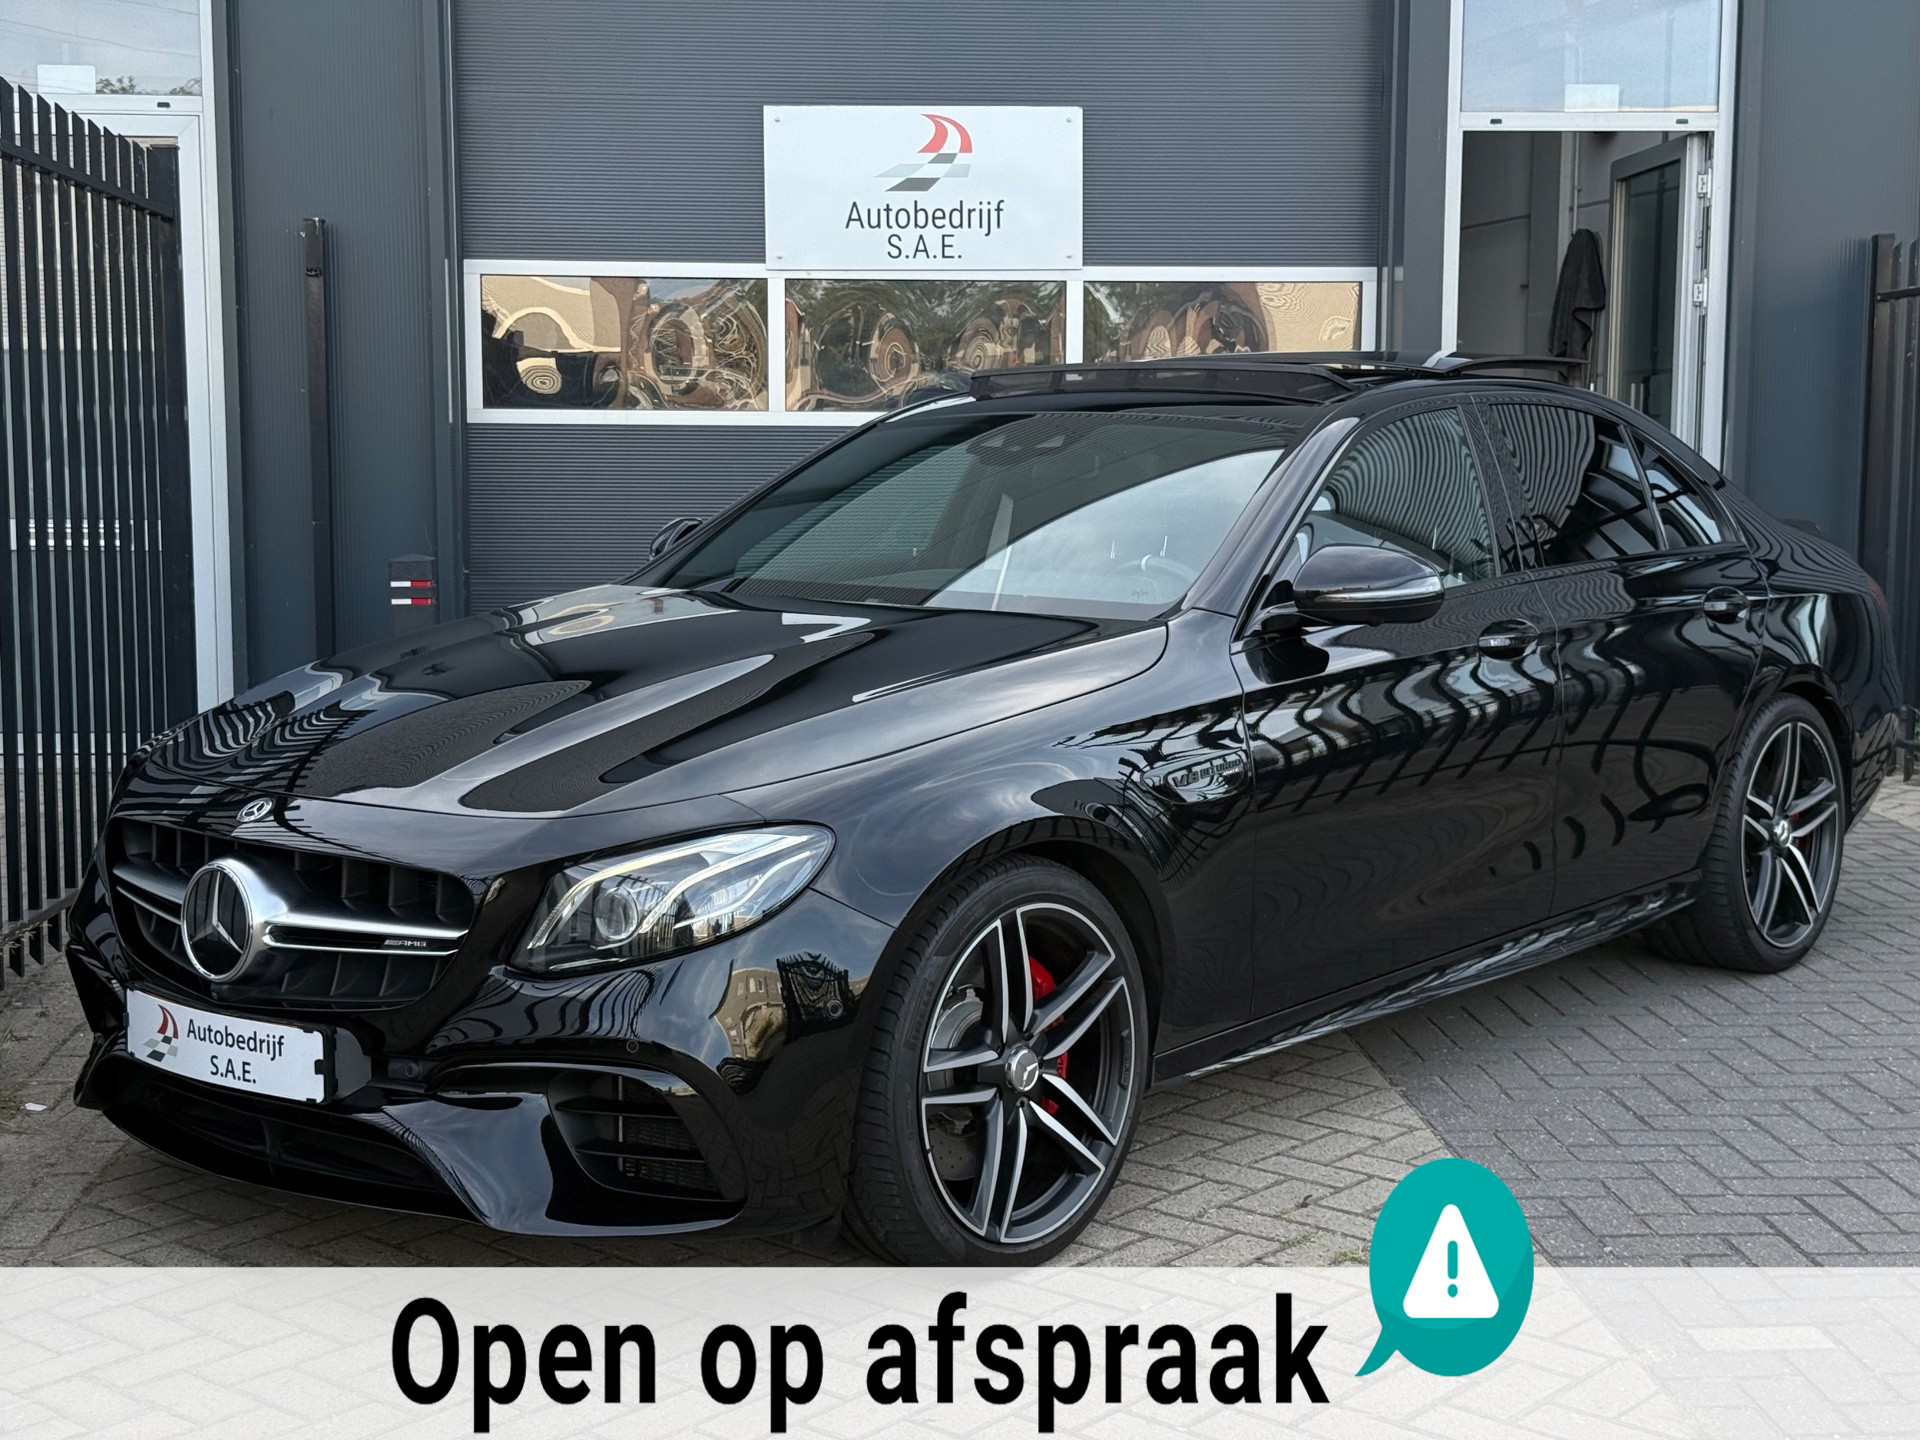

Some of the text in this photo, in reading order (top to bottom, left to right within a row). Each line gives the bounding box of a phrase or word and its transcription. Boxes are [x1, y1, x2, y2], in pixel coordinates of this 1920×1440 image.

[845, 200, 1005, 236] Autobedrijf
[887, 234, 962, 259] S.A.E.
[1172, 770, 1200, 787] V8
[397, 939, 427, 948] AMG
[186, 1018, 285, 1061] Autobedrijf
[209, 1055, 257, 1084] S.A.E.
